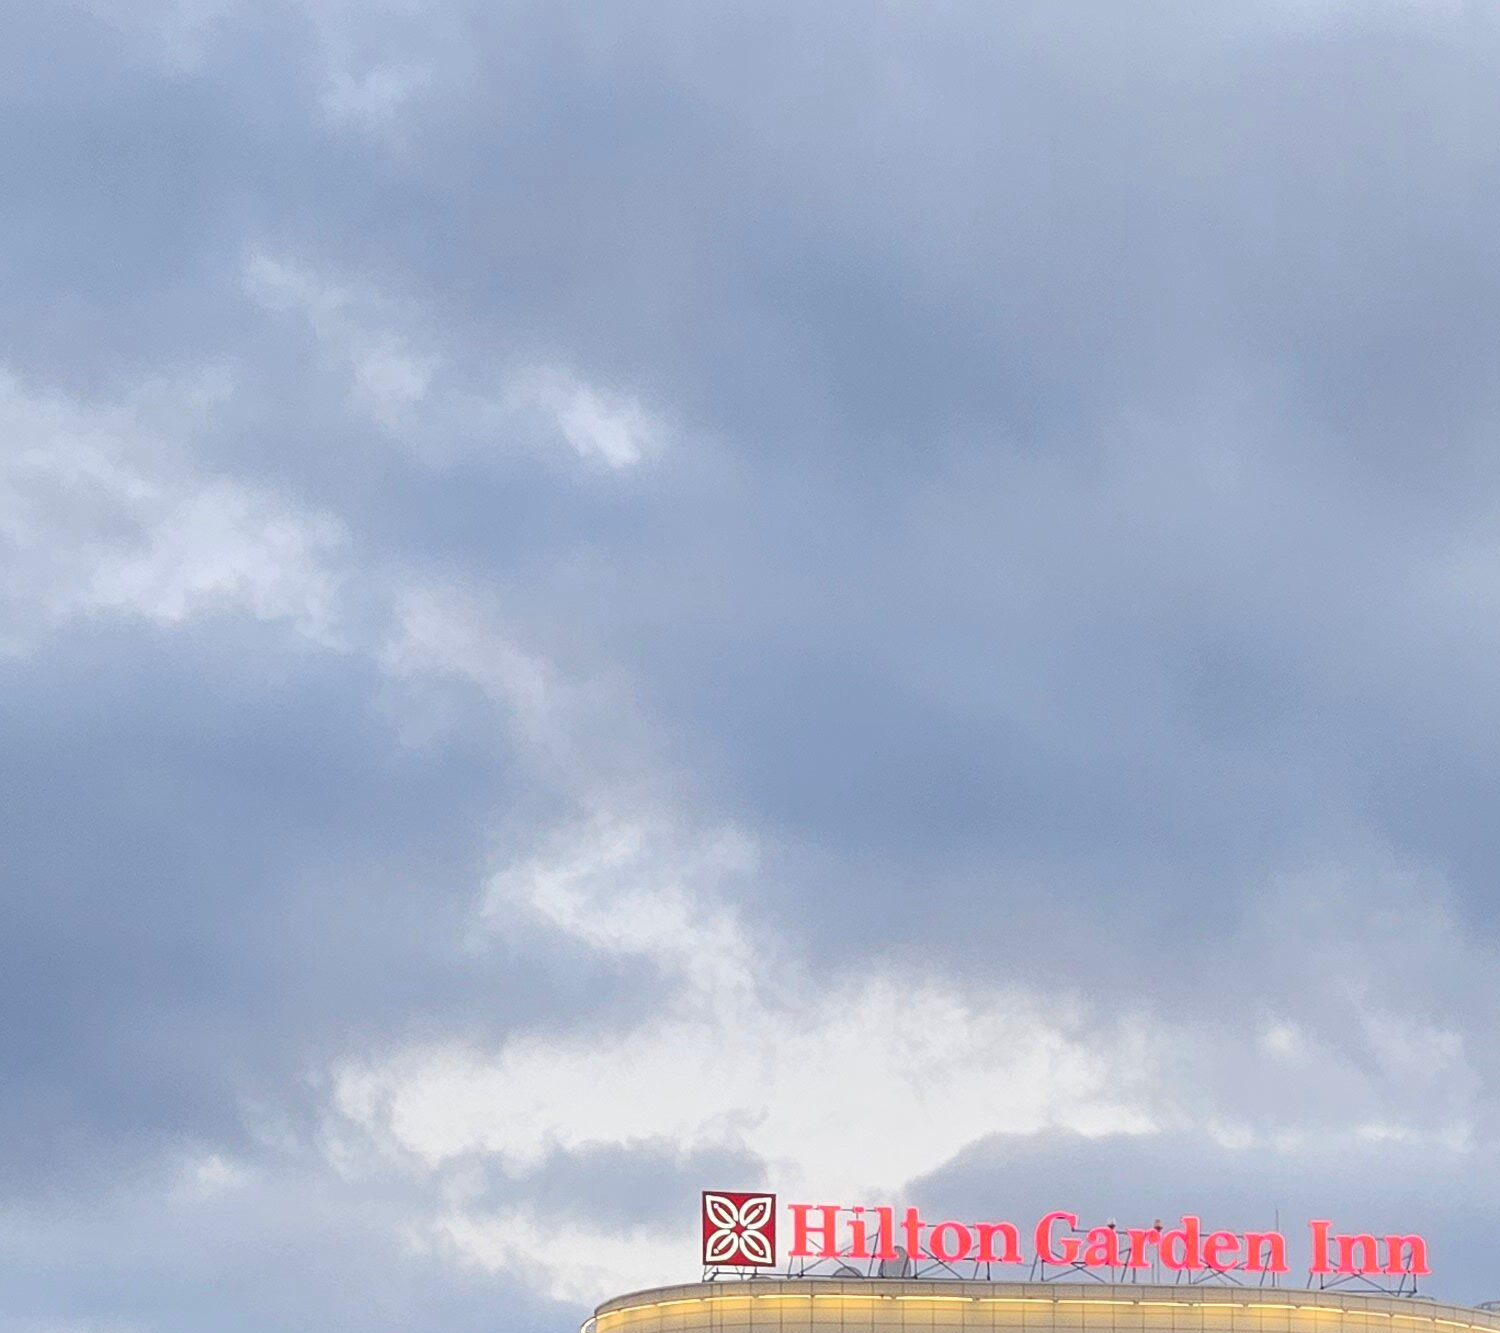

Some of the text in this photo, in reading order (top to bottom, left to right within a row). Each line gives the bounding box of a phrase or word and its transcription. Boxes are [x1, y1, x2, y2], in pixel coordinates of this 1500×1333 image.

[787, 1203, 1432, 1275] Hilton Garden Inn
